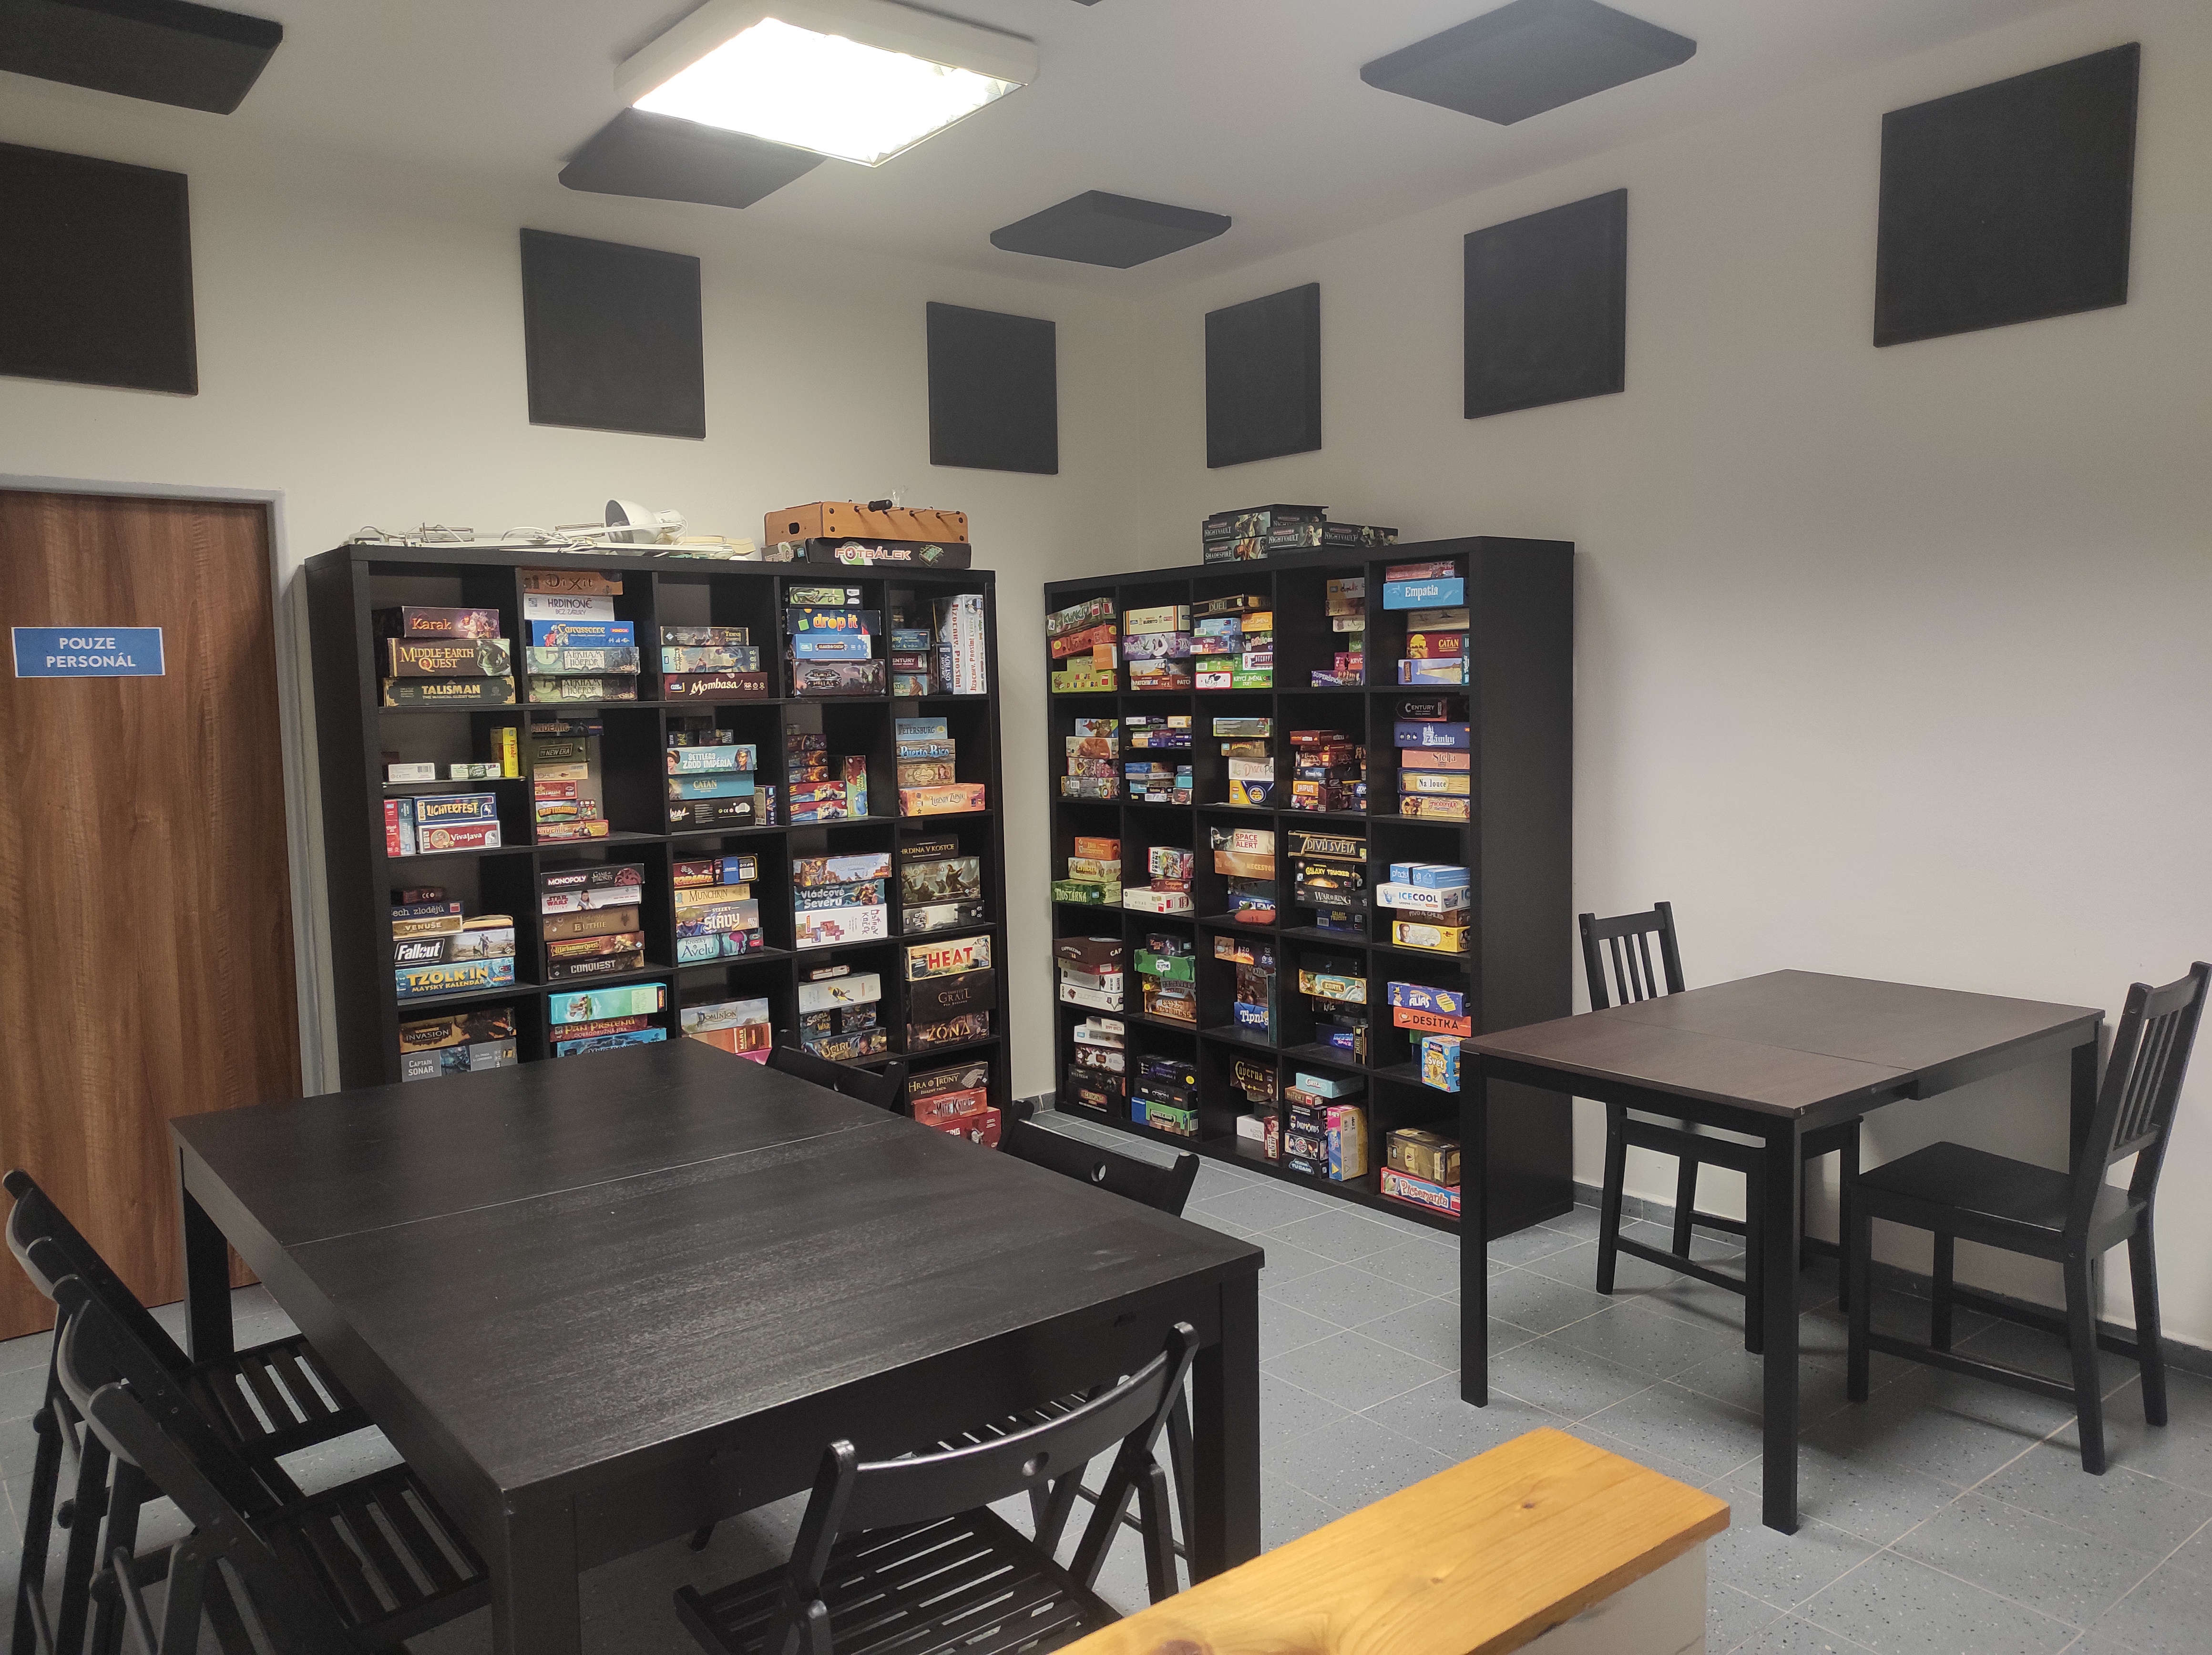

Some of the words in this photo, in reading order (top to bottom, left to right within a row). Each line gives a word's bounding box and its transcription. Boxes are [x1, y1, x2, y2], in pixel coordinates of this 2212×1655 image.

[1204, 526, 1231, 537] NIGHTVAULT
[1324, 532, 1358, 542] NIGHTVAULT
[1268, 533, 1299, 544] NIGHTVAULT
[834, 546, 911, 561] FOTBÁLEK
[1205, 550, 1232, 560] SHADESPIRE
[1405, 584, 1438, 601] Empatia
[548, 597, 593, 609] HRDINOVÉ
[1209, 602, 1227, 612] DUEL
[412, 617, 452, 630] Karak
[813, 613, 846, 632] drop
[847, 613, 858, 629] it
[59, 637, 116, 650] POUZE
[1438, 639, 1459, 648] CATAN
[46, 652, 137, 668] PERSONÁL
[399, 646, 475, 663] MIDDLE-EARTH
[565, 650, 603, 658] ARKHAM
[418, 657, 461, 672] QUEST
[570, 658, 599, 667] HORROR
[563, 679, 601, 687] ARKHAM
[689, 678, 744, 696] Mombasa
[421, 684, 481, 695] TALISMAN
[1405, 703, 1435, 713] CENTURY
[531, 723, 570, 733] ANDEMIC
[898, 723, 935, 736] PETERSBURG
[546, 748, 559, 756] NEW
[559, 747, 570, 756] ERA
[688, 753, 716, 761] SETTLERS
[900, 745, 928, 759] Puerto
[929, 744, 950, 758] Rico
[1432, 752, 1456, 763] Stella
[683, 760, 701, 769] ZROD
[703, 756, 733, 768] IMPÉRIA
[693, 780, 717, 788] CATAN
[1297, 784, 1314, 793] JAIPUR
[1419, 778, 1427, 787] Na
[1429, 778, 1447, 787] louce
[426, 802, 479, 816] LICHTERFEST
[538, 806, 578, 817] DRAFTOSAURUS
[450, 832, 483, 843] VivaJava
[1235, 833, 1258, 841] SPACE
[931, 843, 955, 852] KOSTCE
[1235, 841, 1258, 849] ALERT
[1307, 838, 1328, 851] DIVŮ
[1329, 839, 1355, 854] SVĚTA
[1305, 866, 1325, 875] GALAXY
[1326, 868, 1350, 878] TRUCKER
[548, 875, 587, 885] MONOPOLY
[673, 874, 713, 885] FORMUL
[689, 889, 728, 903] MUNCHKIN
[799, 887, 845, 899] Vládcové
[1055, 888, 1087, 903] MOŠTÁRNA
[1314, 891, 1330, 901] WAR
[1334, 894, 1352, 905] RING
[1398, 891, 1438, 903] ICECOOL
[804, 898, 843, 910] Severu
[405, 921, 442, 931] VENUŠE
[573, 921, 608, 933] EUTHIE
[870, 909, 881, 935] OSTROV
[397, 941, 441, 961] Fallout
[681, 943, 714, 959] Avelu
[1061, 946, 1082, 956] CAPPUCCINO
[928, 947, 973, 970] HEAT
[570, 960, 616, 974] CONQUEST
[938, 988, 972, 1003] GRAIL
[1409, 997, 1430, 1009] ALIAS
[1239, 1010, 1264, 1024] Tipni
[1413, 1015, 1459, 1030] DESÍTKA
[564, 1025, 588, 1035] PÁN
[590, 1016, 635, 1032] PRSTENŮ
[406, 1029, 450, 1042] INVASION
[926, 1022, 972, 1042] ZÓNA
[409, 1059, 433, 1068] CAPTAIN
[1427, 1055, 1444, 1070] Svět
[408, 1066, 434, 1077] SONAR
[1235, 1060, 1264, 1082] Caverna
[908, 1081, 927, 1093] HRA
[933, 1073, 961, 1088] TRŮNY
[952, 1097, 974, 1114] KNIGHT
[1400, 1179, 1449, 1208] Pictomania
